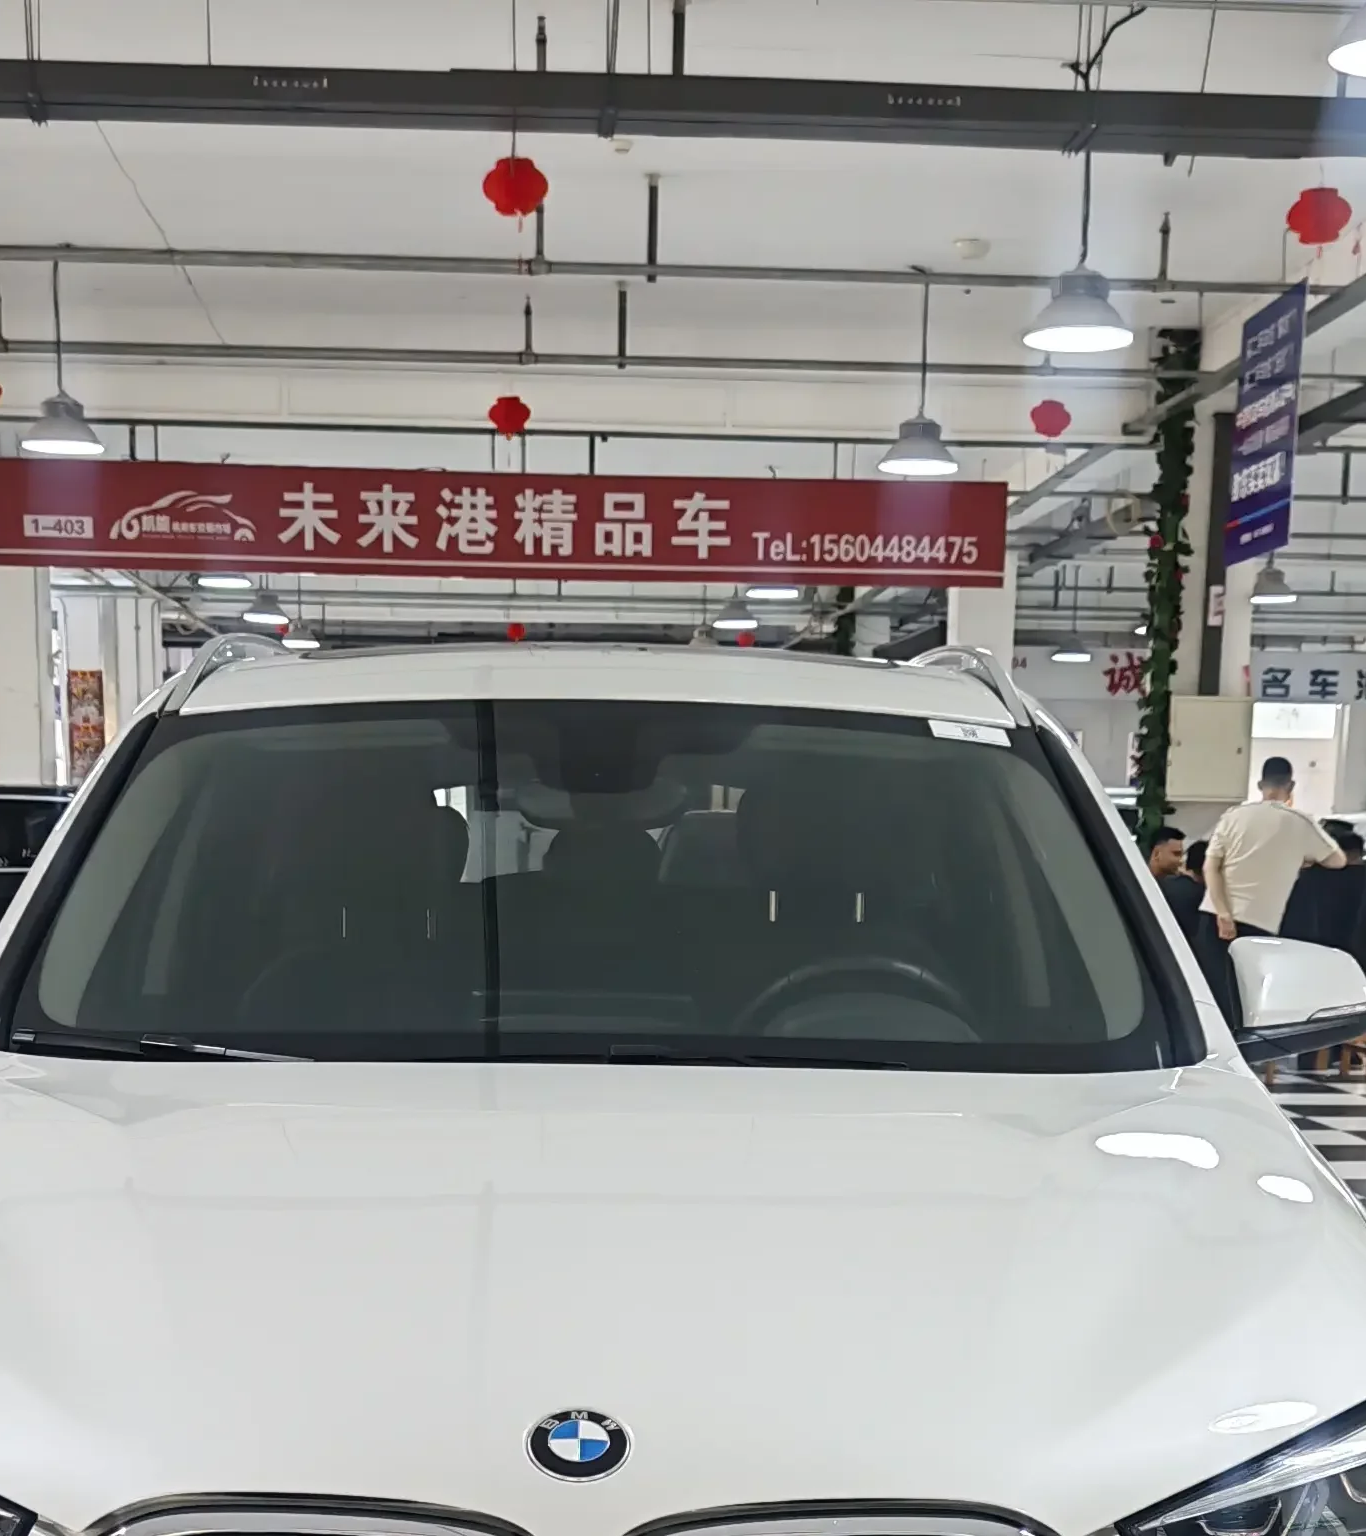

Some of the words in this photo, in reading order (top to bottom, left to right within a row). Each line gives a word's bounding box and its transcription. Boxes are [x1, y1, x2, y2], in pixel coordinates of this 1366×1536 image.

[277, 481, 732, 560] 未来港精品车
[538, 1411, 621, 1430] BMW
